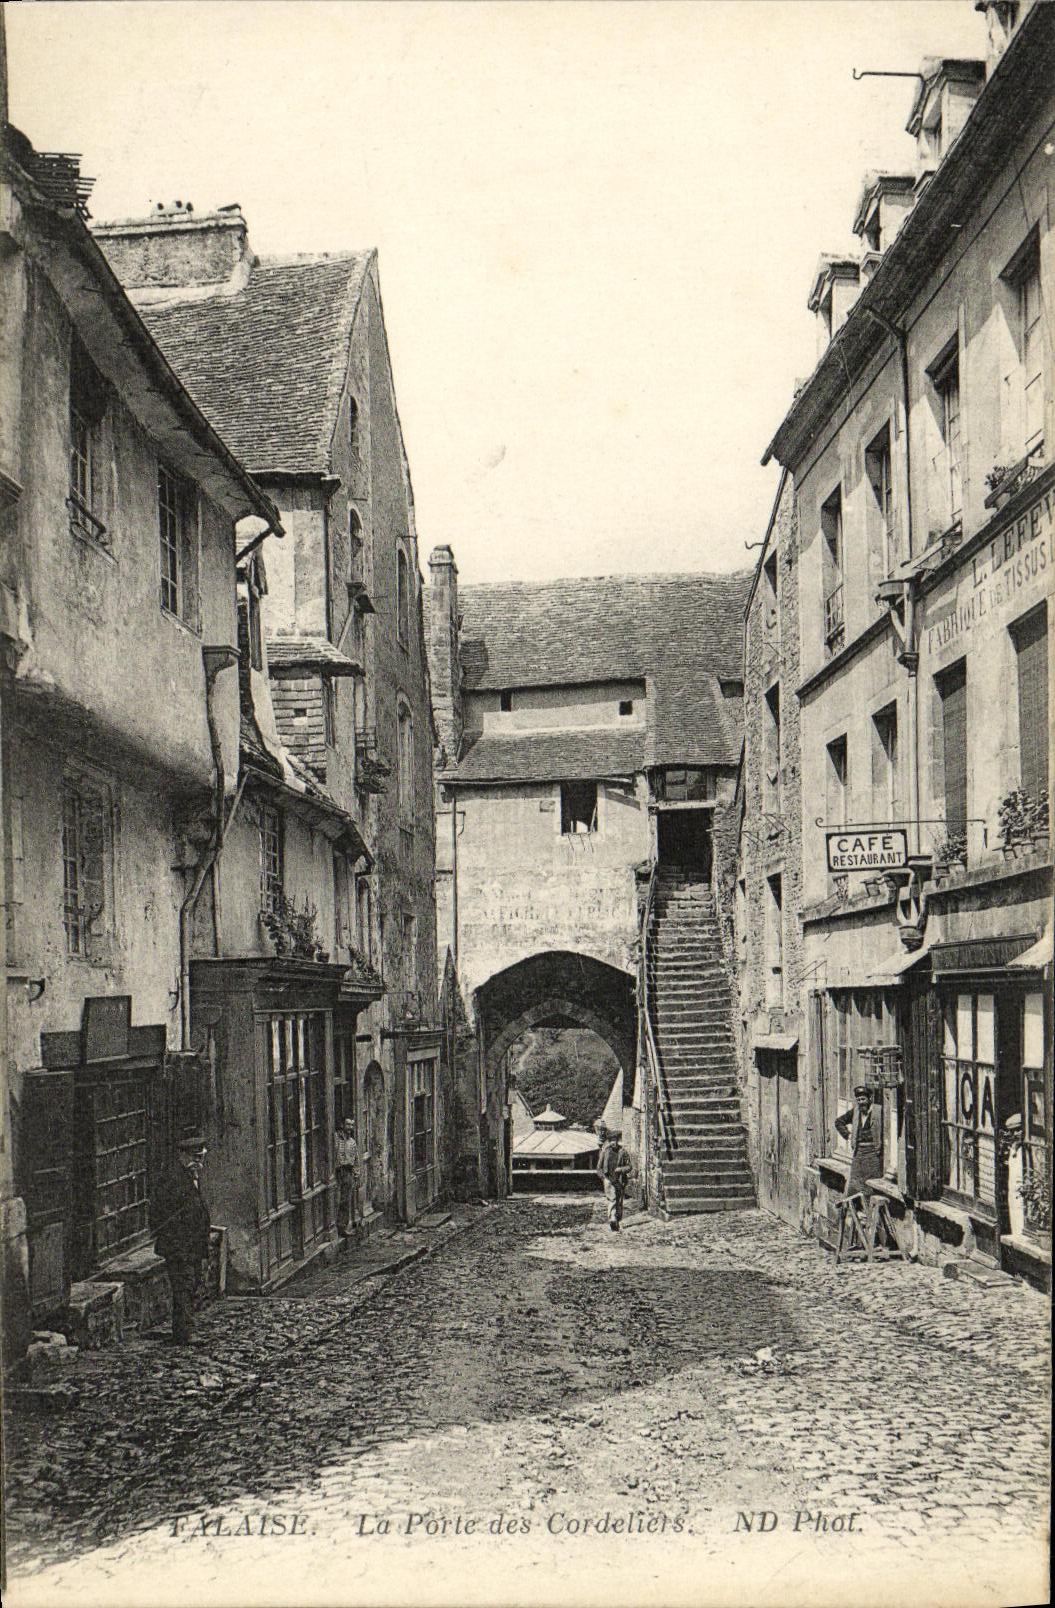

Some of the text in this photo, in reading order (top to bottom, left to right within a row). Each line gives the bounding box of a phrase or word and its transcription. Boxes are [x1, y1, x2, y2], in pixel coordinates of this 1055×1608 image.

[972, 557, 988, 589] L.
[928, 588, 987, 655] FABRIQUE
[1004, 541, 1047, 597] TISSUS
[832, 852, 903, 867] RESTAURANT
